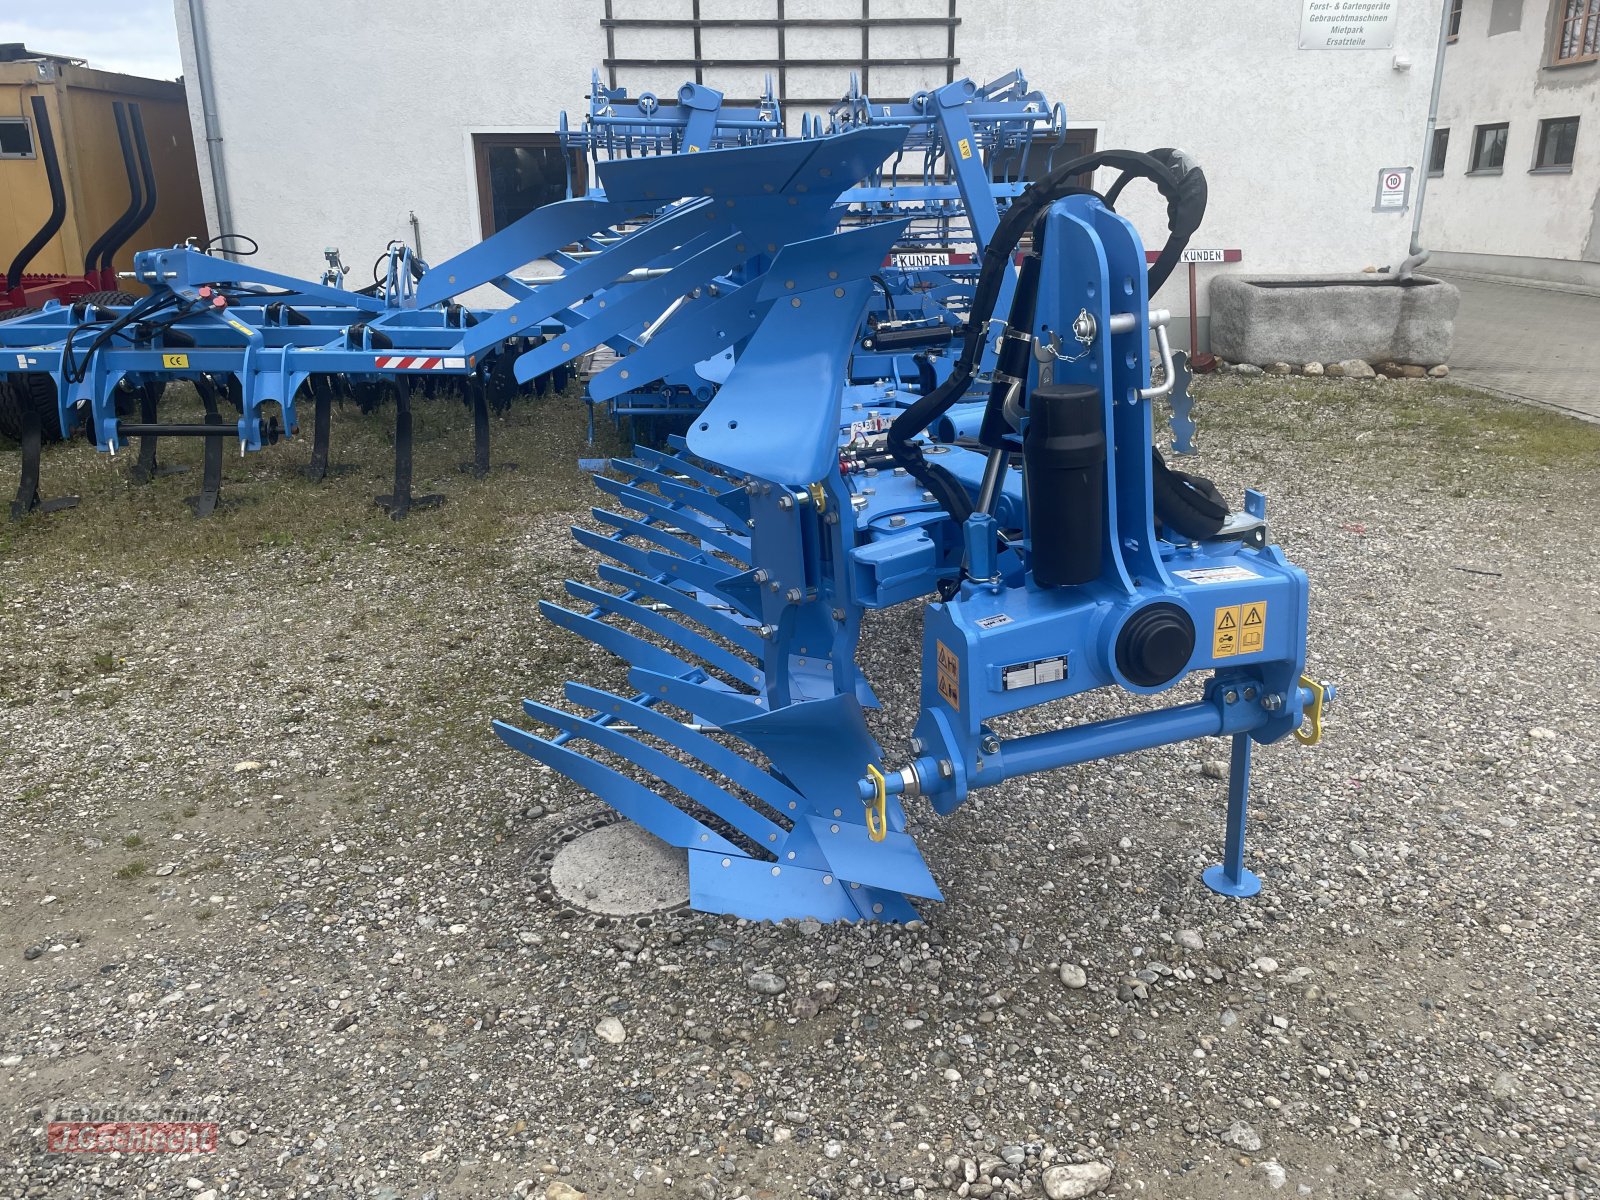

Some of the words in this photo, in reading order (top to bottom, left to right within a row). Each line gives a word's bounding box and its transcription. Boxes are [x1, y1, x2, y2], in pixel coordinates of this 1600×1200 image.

[1309, 2, 1332, 10] Forst-
[1334, 2, 1341, 10] &
[1342, 2, 1391, 11] Gartengeräte
[1309, 14, 1388, 22] Gebrauchtmaschinen
[1330, 26, 1364, 35] Mietpark
[1326, 38, 1366, 46] Ersatzteile
[1390, 177, 1398, 186] 10
[899, 255, 946, 267] KUNDEN
[1183, 251, 1222, 262] KUNDEN
